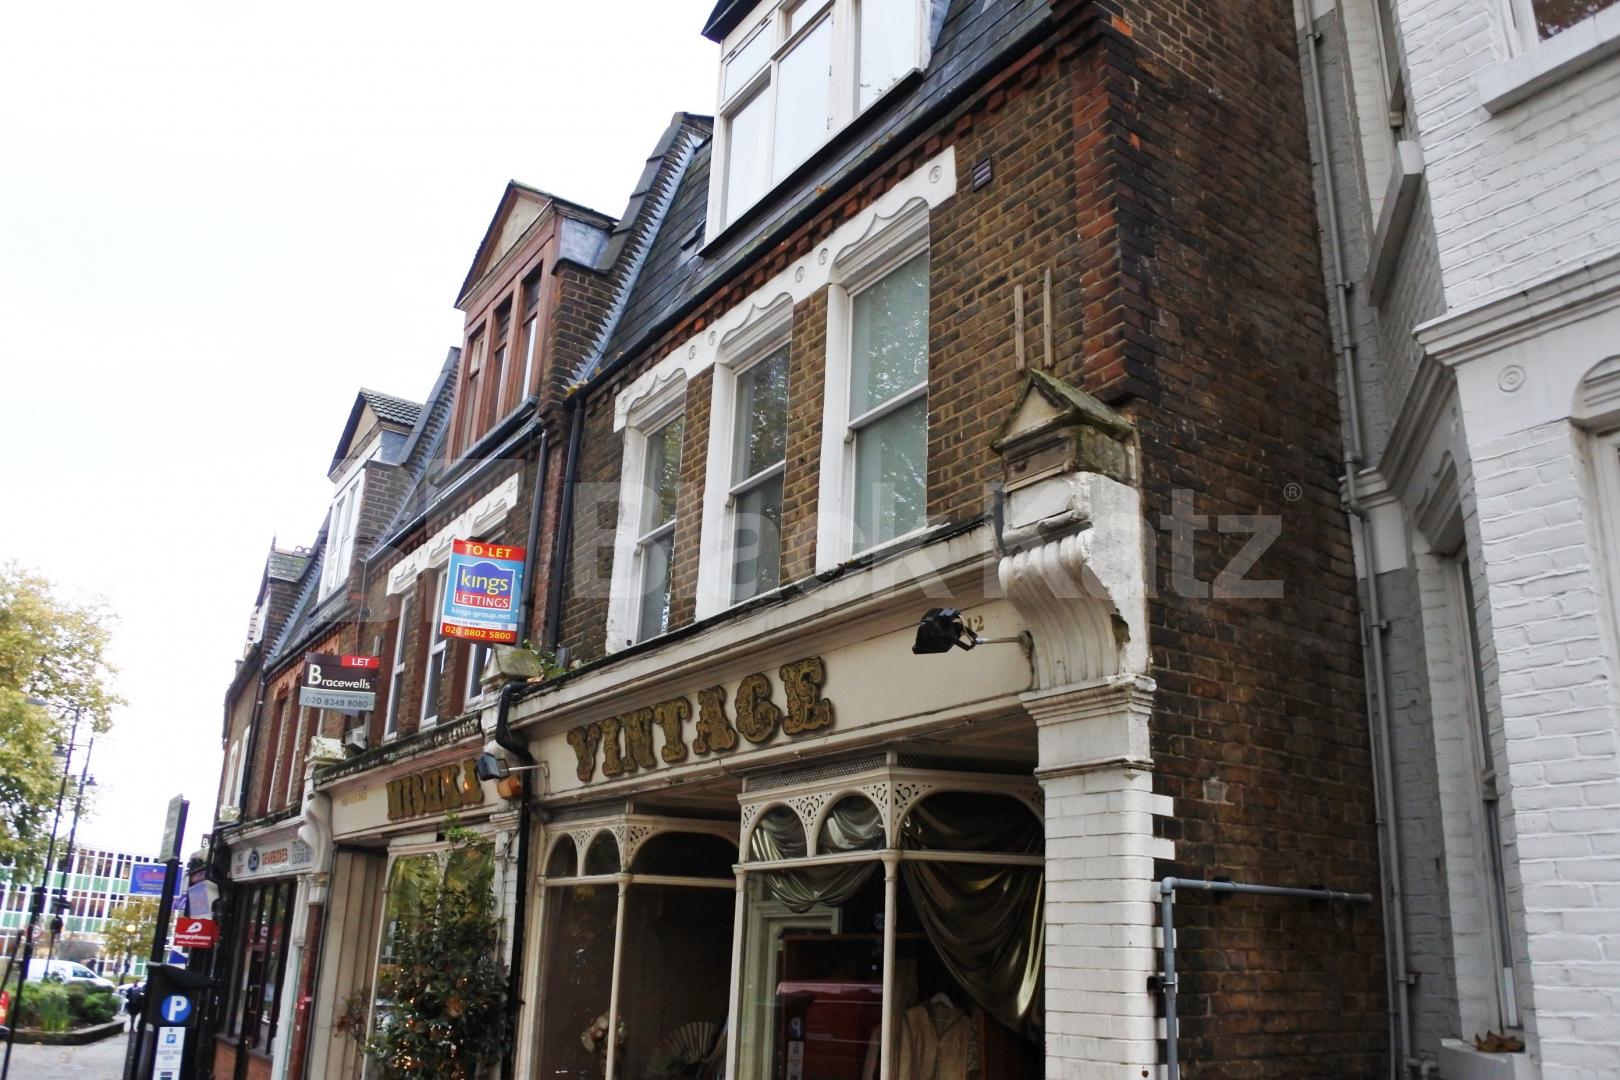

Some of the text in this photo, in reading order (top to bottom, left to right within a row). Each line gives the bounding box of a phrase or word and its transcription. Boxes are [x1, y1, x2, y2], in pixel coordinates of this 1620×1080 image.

[465, 544, 512, 558] TO LET
[460, 568, 509, 596] kings
[455, 594, 510, 608] LETTINGS
[451, 607, 511, 620] kings-group.net
[445, 625, 511, 640] 020 8802 5800
[351, 657, 371, 666] LET
[307, 663, 371, 690] Bracewells
[305, 696, 322, 704] 020
[565, 656, 837, 783] VINTAGE
[167, 995, 188, 1021] P
